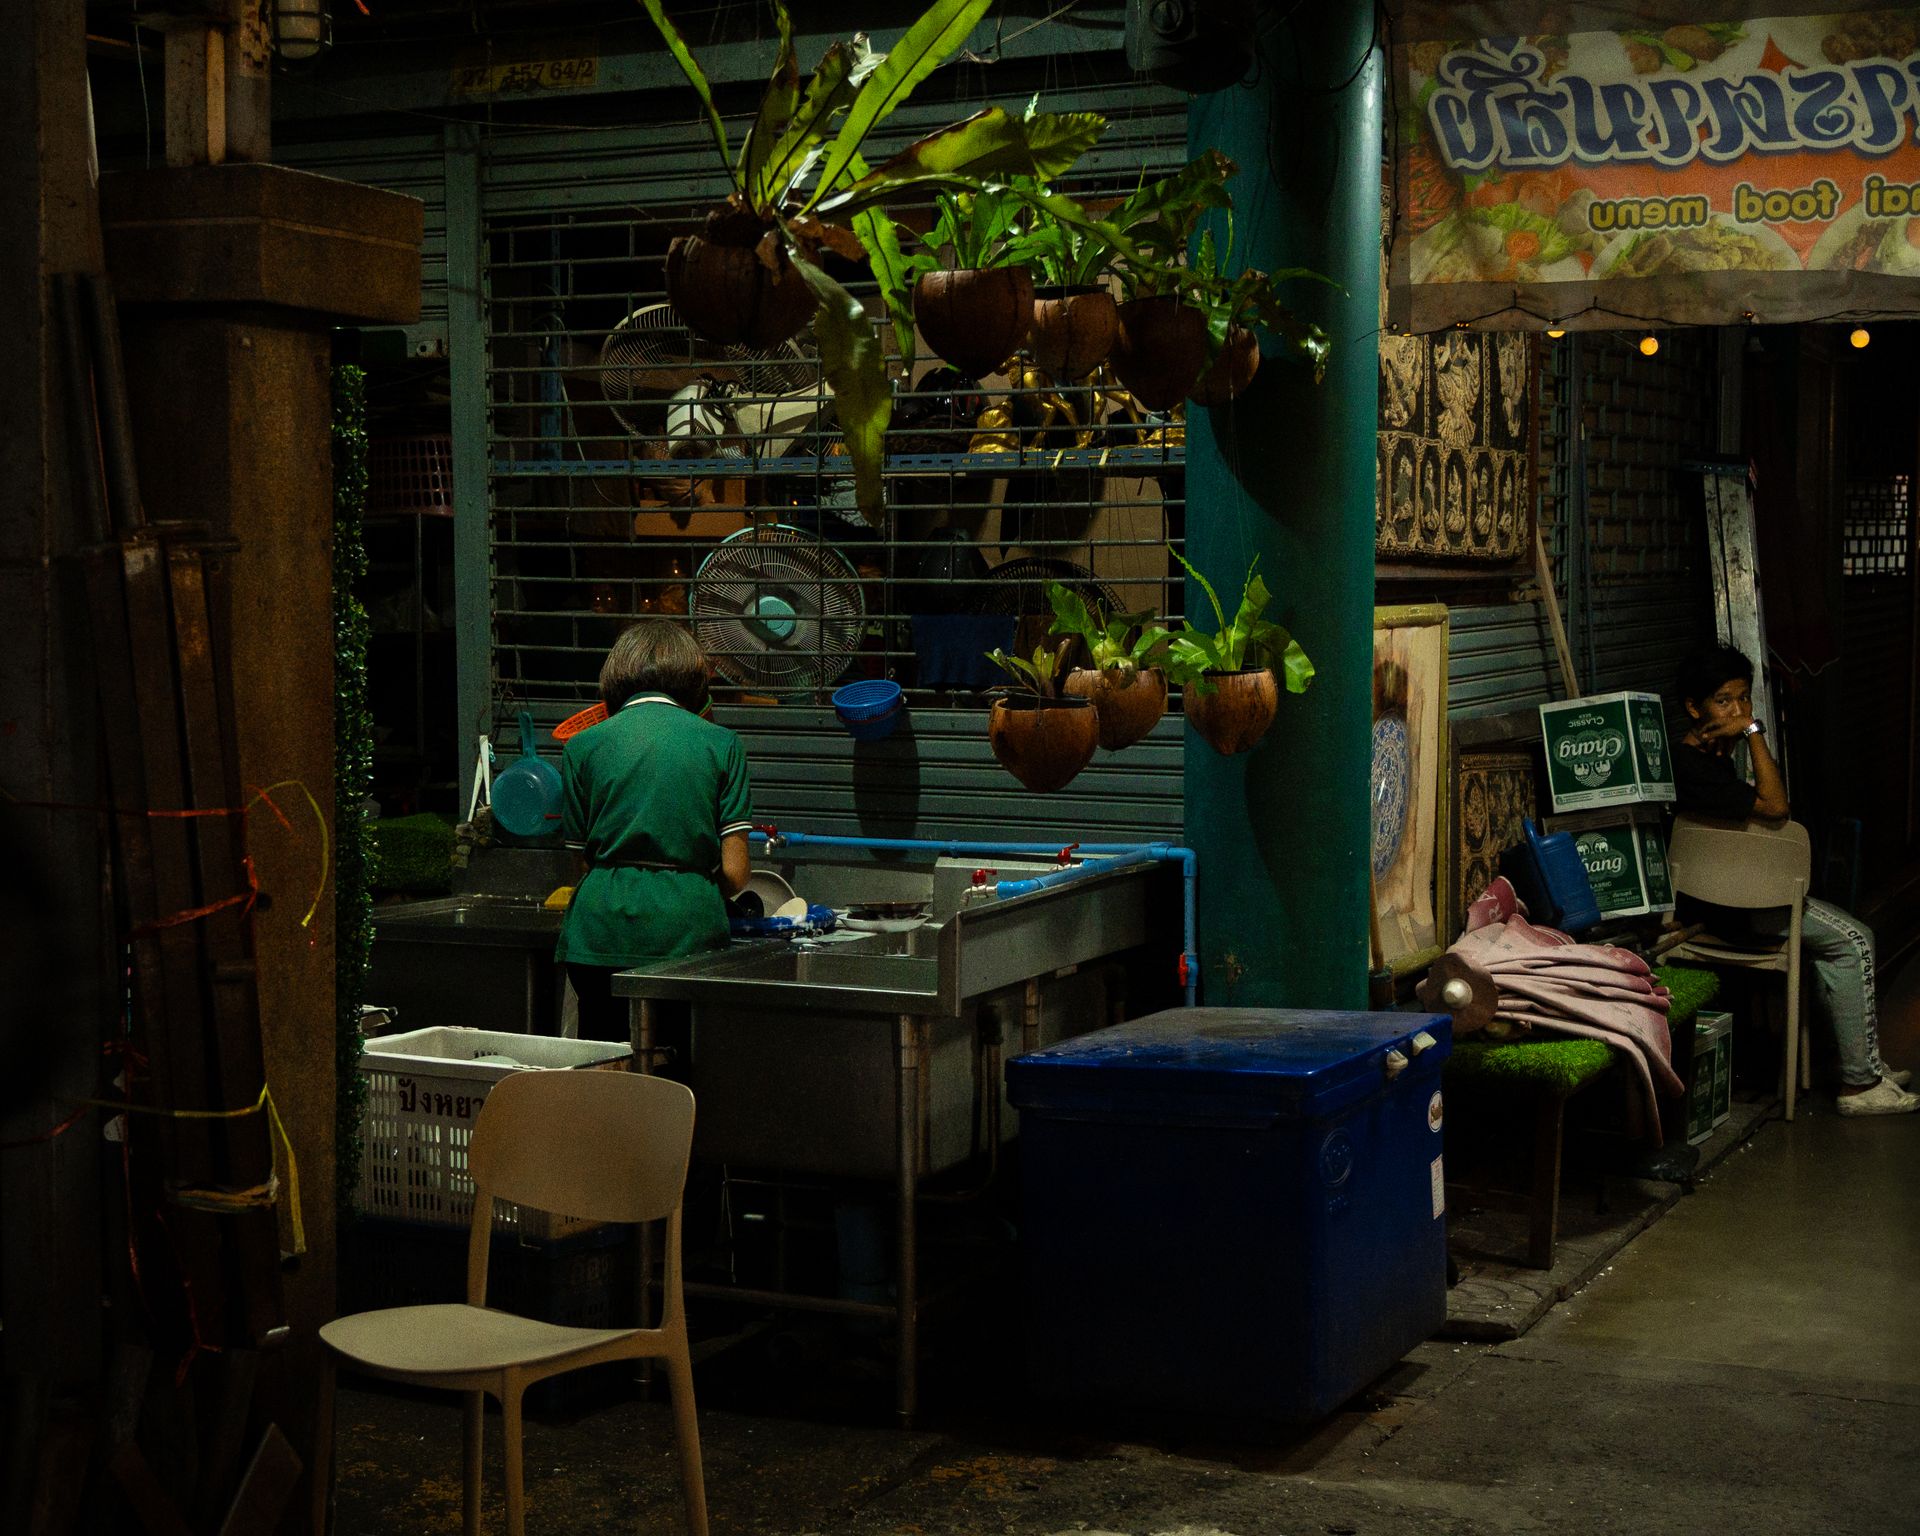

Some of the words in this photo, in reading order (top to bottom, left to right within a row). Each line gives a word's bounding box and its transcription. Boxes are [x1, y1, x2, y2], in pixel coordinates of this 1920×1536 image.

[550, 57, 593, 81] 64/2
[1567, 716, 1605, 728] CLASSIC
[1559, 736, 1622, 760] Chang
